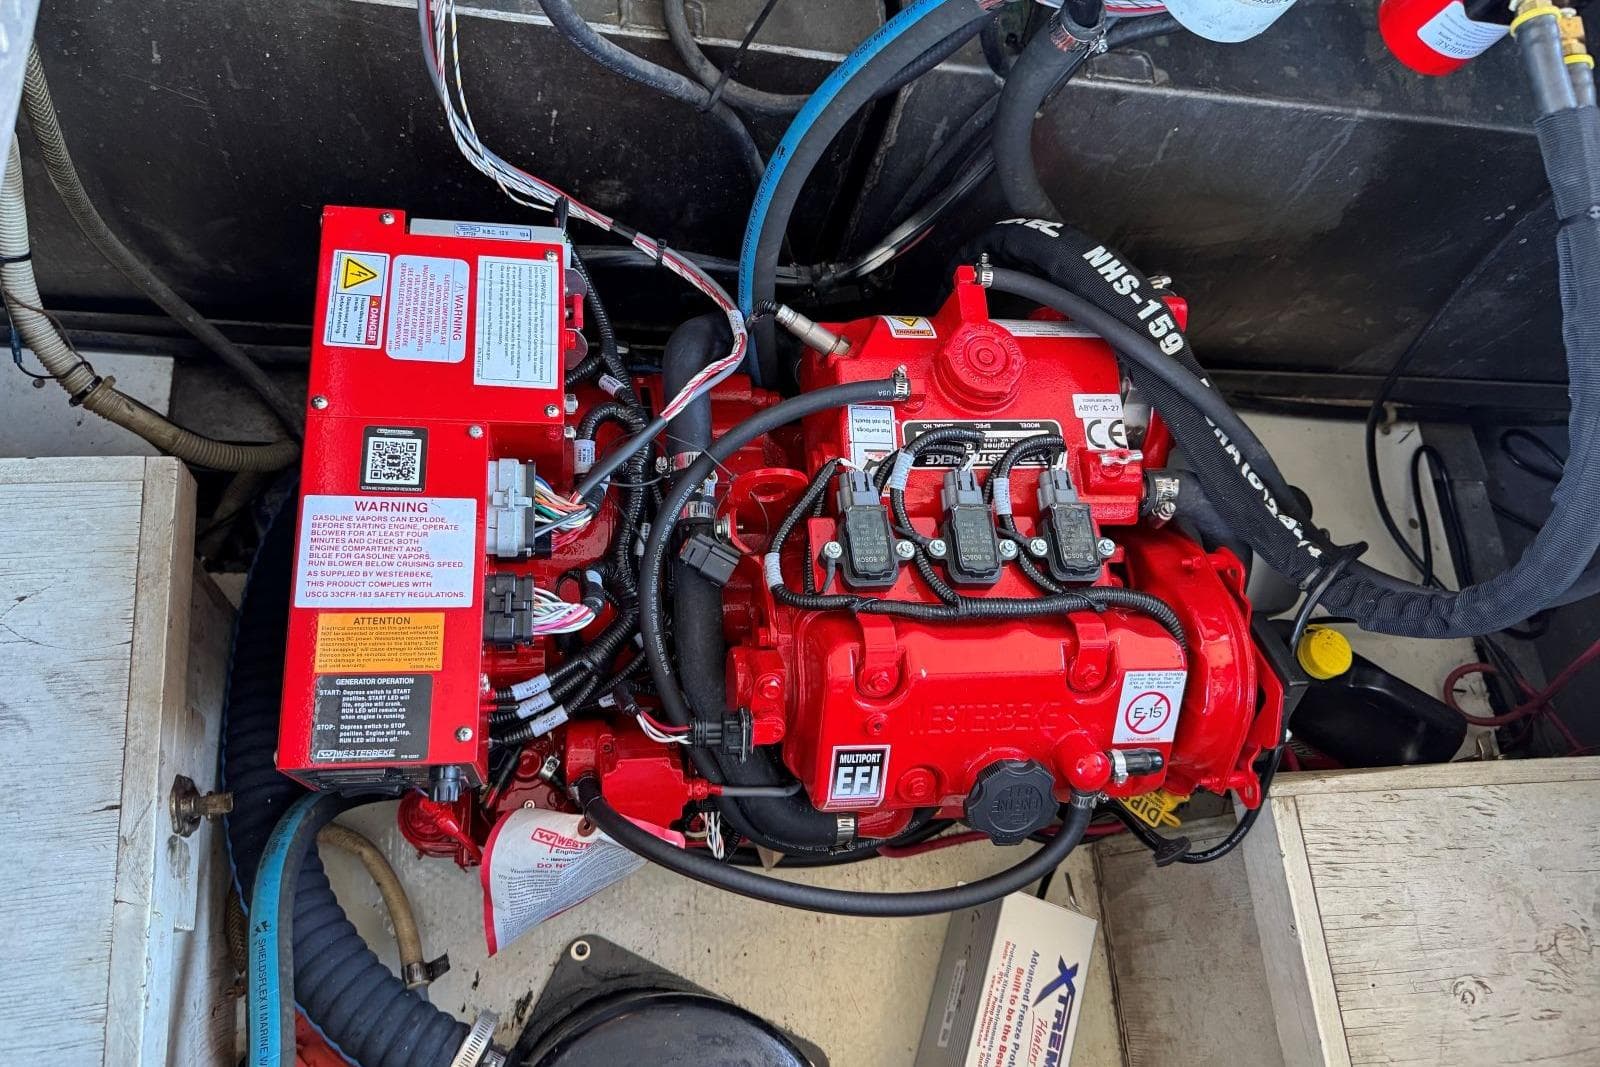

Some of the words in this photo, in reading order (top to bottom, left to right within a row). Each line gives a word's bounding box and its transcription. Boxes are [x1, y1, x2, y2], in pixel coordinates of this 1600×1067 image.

[1083, 245, 1184, 356] NHS-159
[367, 307, 378, 341] DANGER
[452, 294, 463, 340] WARNING
[1087, 419, 1127, 449] CE
[355, 501, 427, 512] WARNING
[354, 617, 410, 625] ATTENTION
[1134, 707, 1162, 718] E-15
[335, 749, 396, 758] WESTERBEKE
[840, 754, 881, 763] MULTIPORT
[836, 766, 880, 795] EFI
[1130, 798, 1159, 822] DIP
[257, 938, 268, 1002] SHIELDSFLEX
[1010, 966, 1025, 993] Built
[1019, 950, 1040, 1002] Advanced
[1008, 993, 1018, 1006] to
[1005, 1007, 1015, 1022] be
[1012, 1002, 1028, 1040] Freeze
[259, 1012, 269, 1058] MARINE
[999, 1022, 1011, 1043] the
